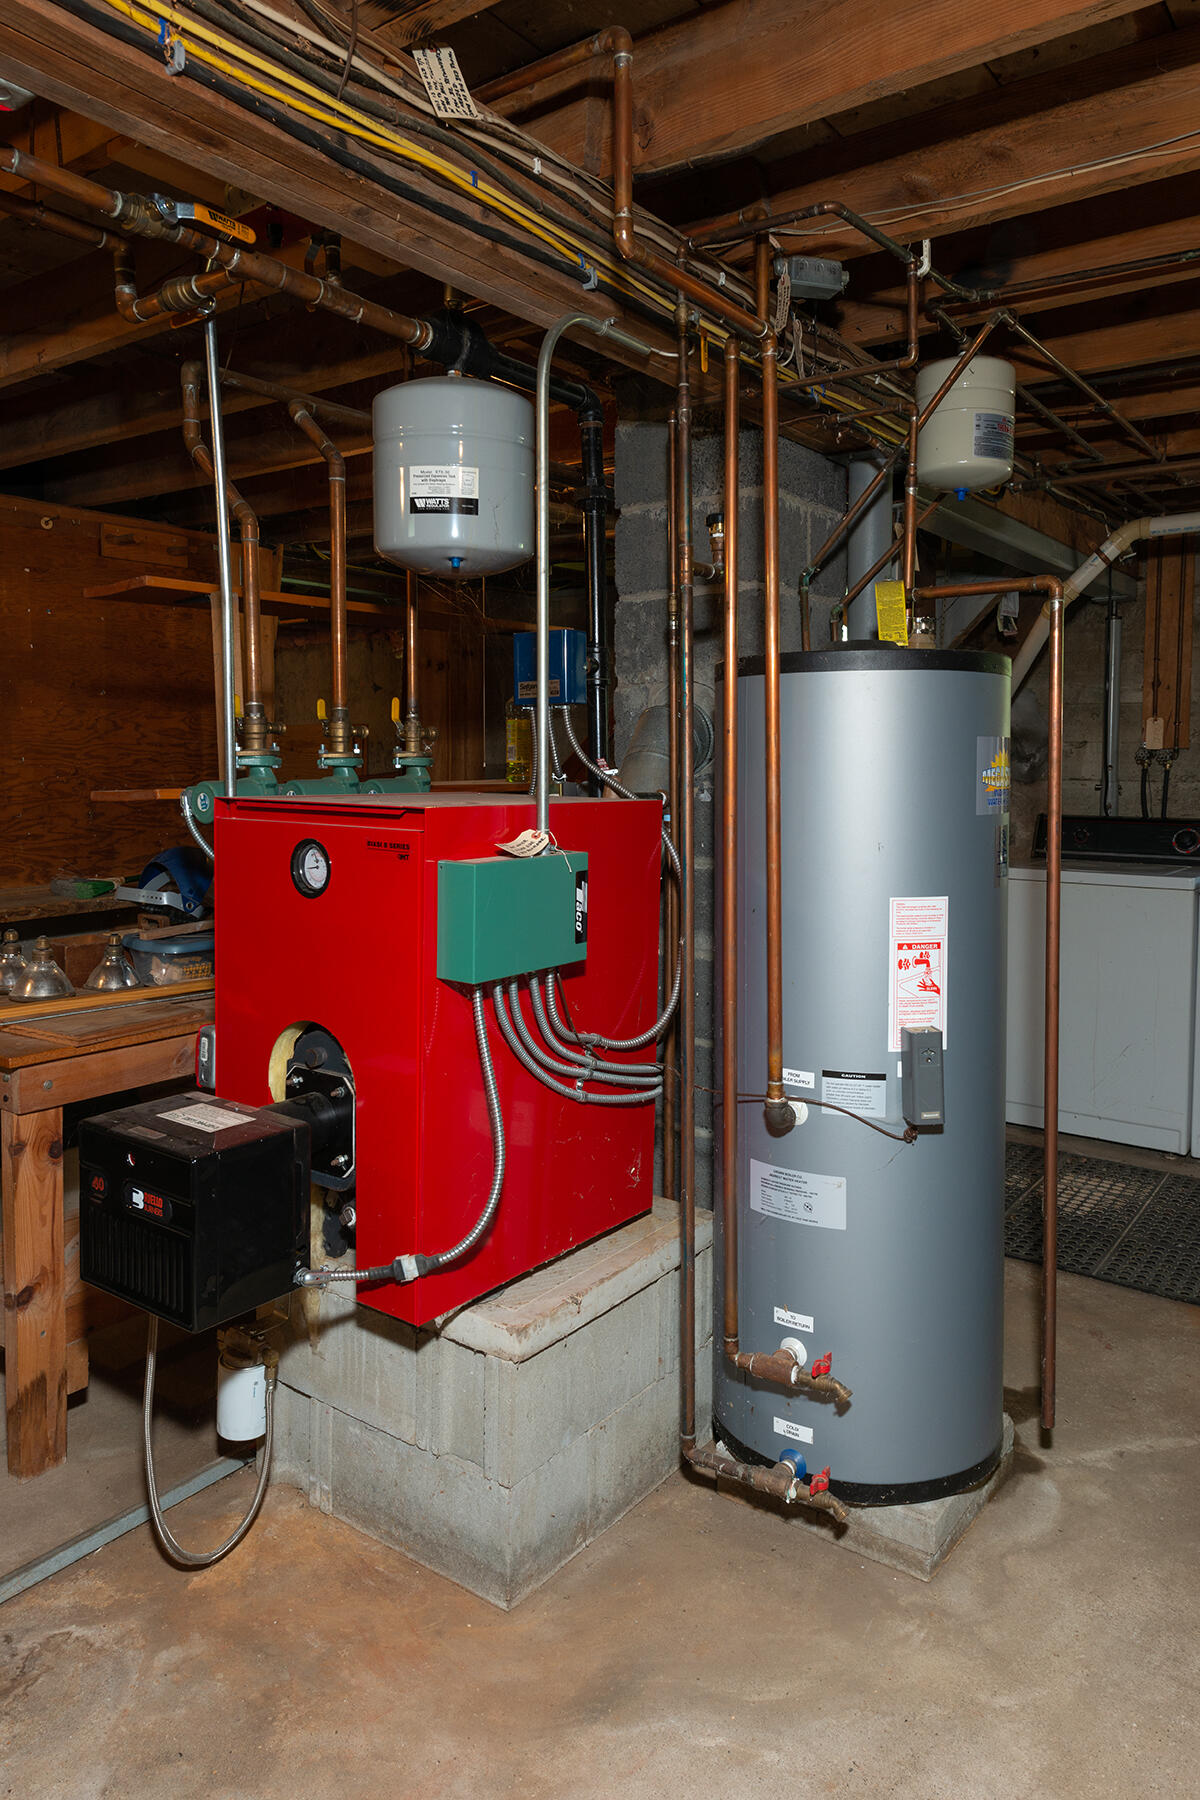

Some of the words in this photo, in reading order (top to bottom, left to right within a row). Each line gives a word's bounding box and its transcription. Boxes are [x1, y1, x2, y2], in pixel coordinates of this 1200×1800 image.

[576, 880, 588, 932] Taco
[92, 1176, 104, 1191] 40
[792, 1320, 810, 1329] RETURN
